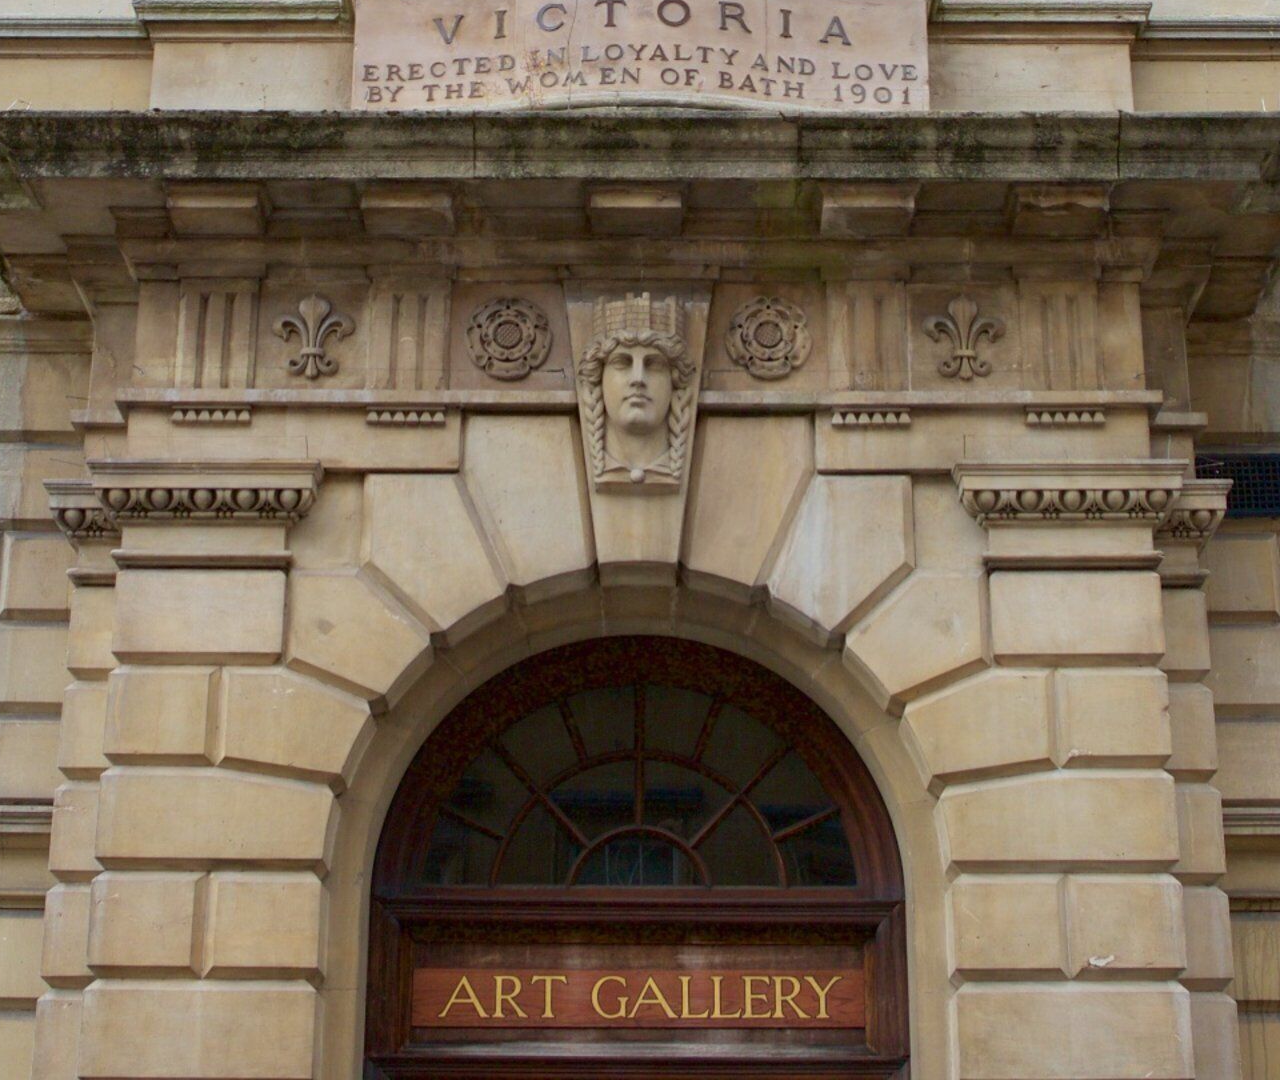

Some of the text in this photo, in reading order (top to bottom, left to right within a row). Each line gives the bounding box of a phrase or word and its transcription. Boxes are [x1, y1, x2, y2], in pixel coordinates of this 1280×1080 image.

[362, 44, 918, 82] ERECTED IN LOYALTY AND LOVE
[367, 67, 910, 105] BY THE WOMEN OF BATH 1901
[437, 975, 843, 1020] ART GALLERY
